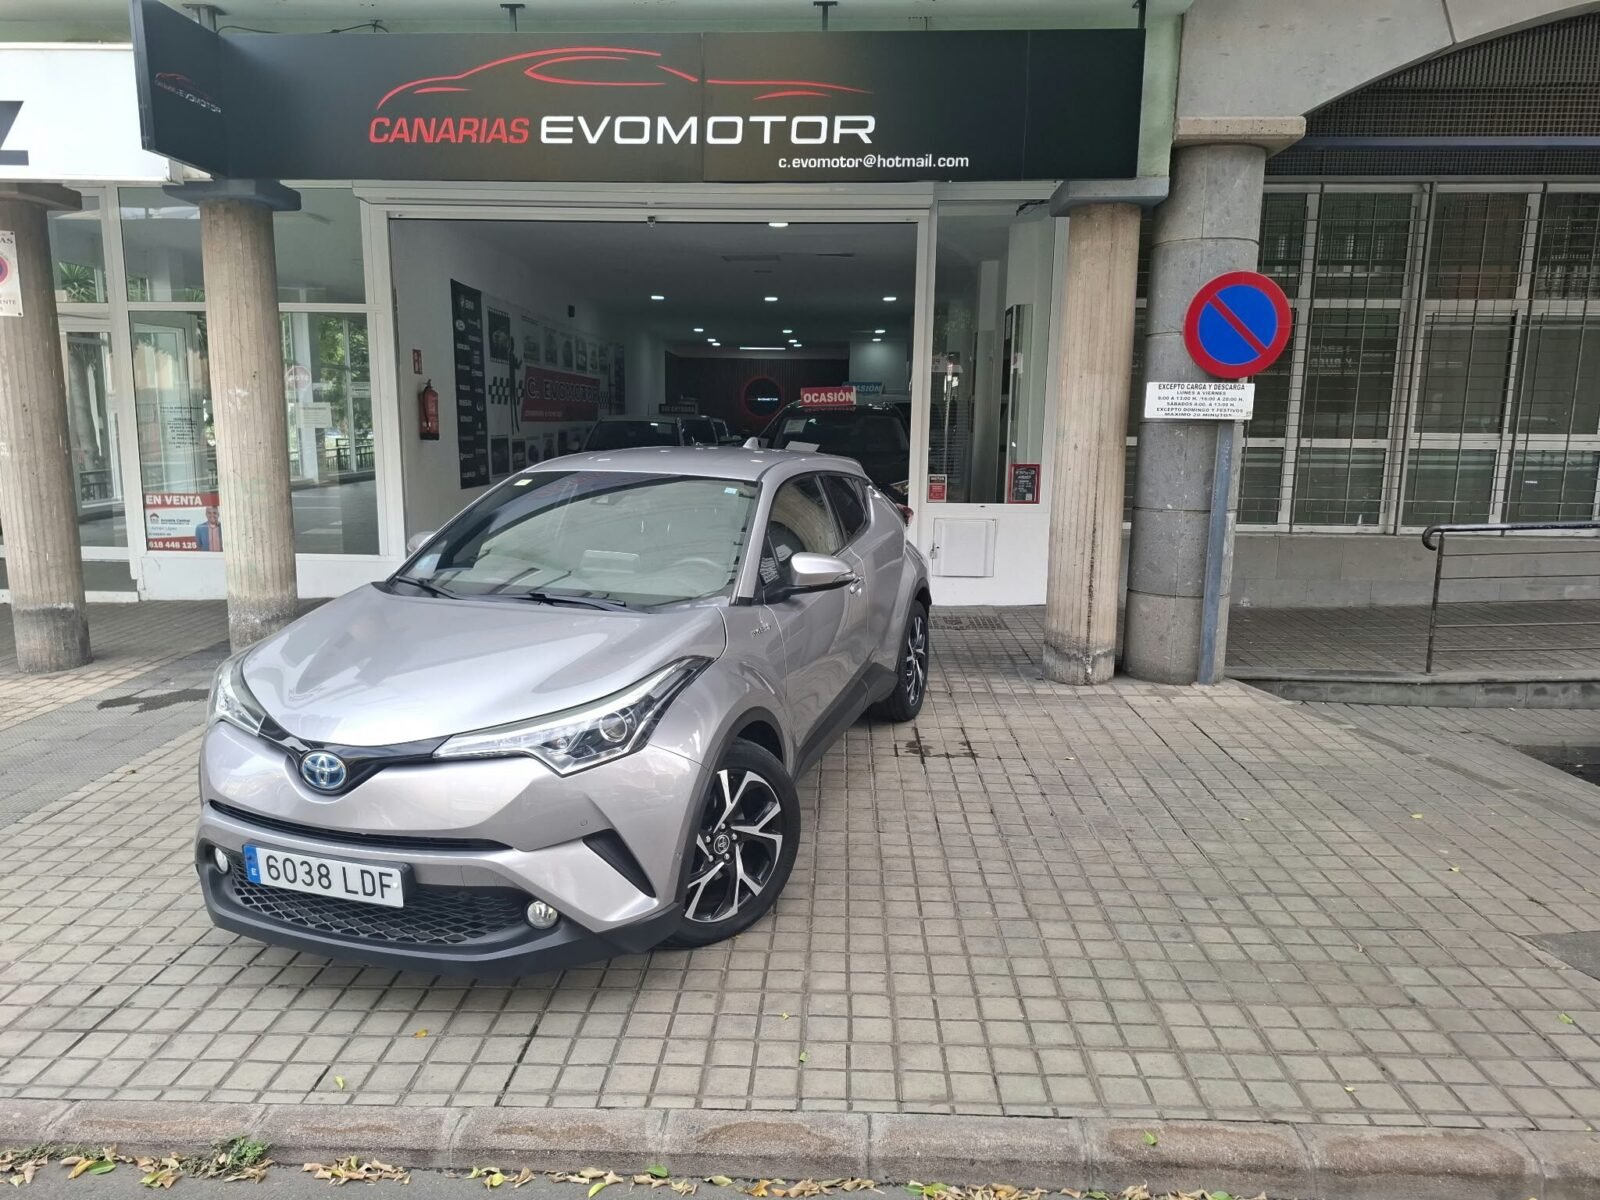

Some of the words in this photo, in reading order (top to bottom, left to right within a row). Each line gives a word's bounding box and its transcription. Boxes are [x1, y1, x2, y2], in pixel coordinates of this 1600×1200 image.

[369, 116, 530, 143] CANARIAS
[540, 115, 876, 145] EVOMOTOR
[778, 153, 969, 168] c.evomotor@hotmail.com
[803, 390, 853, 403] OCASIÓN
[145, 494, 162, 505] EN
[164, 494, 203, 505] VENTA
[250, 867, 258, 876] E
[266, 855, 332, 890] 6038
[342, 866, 393, 899] LDF
